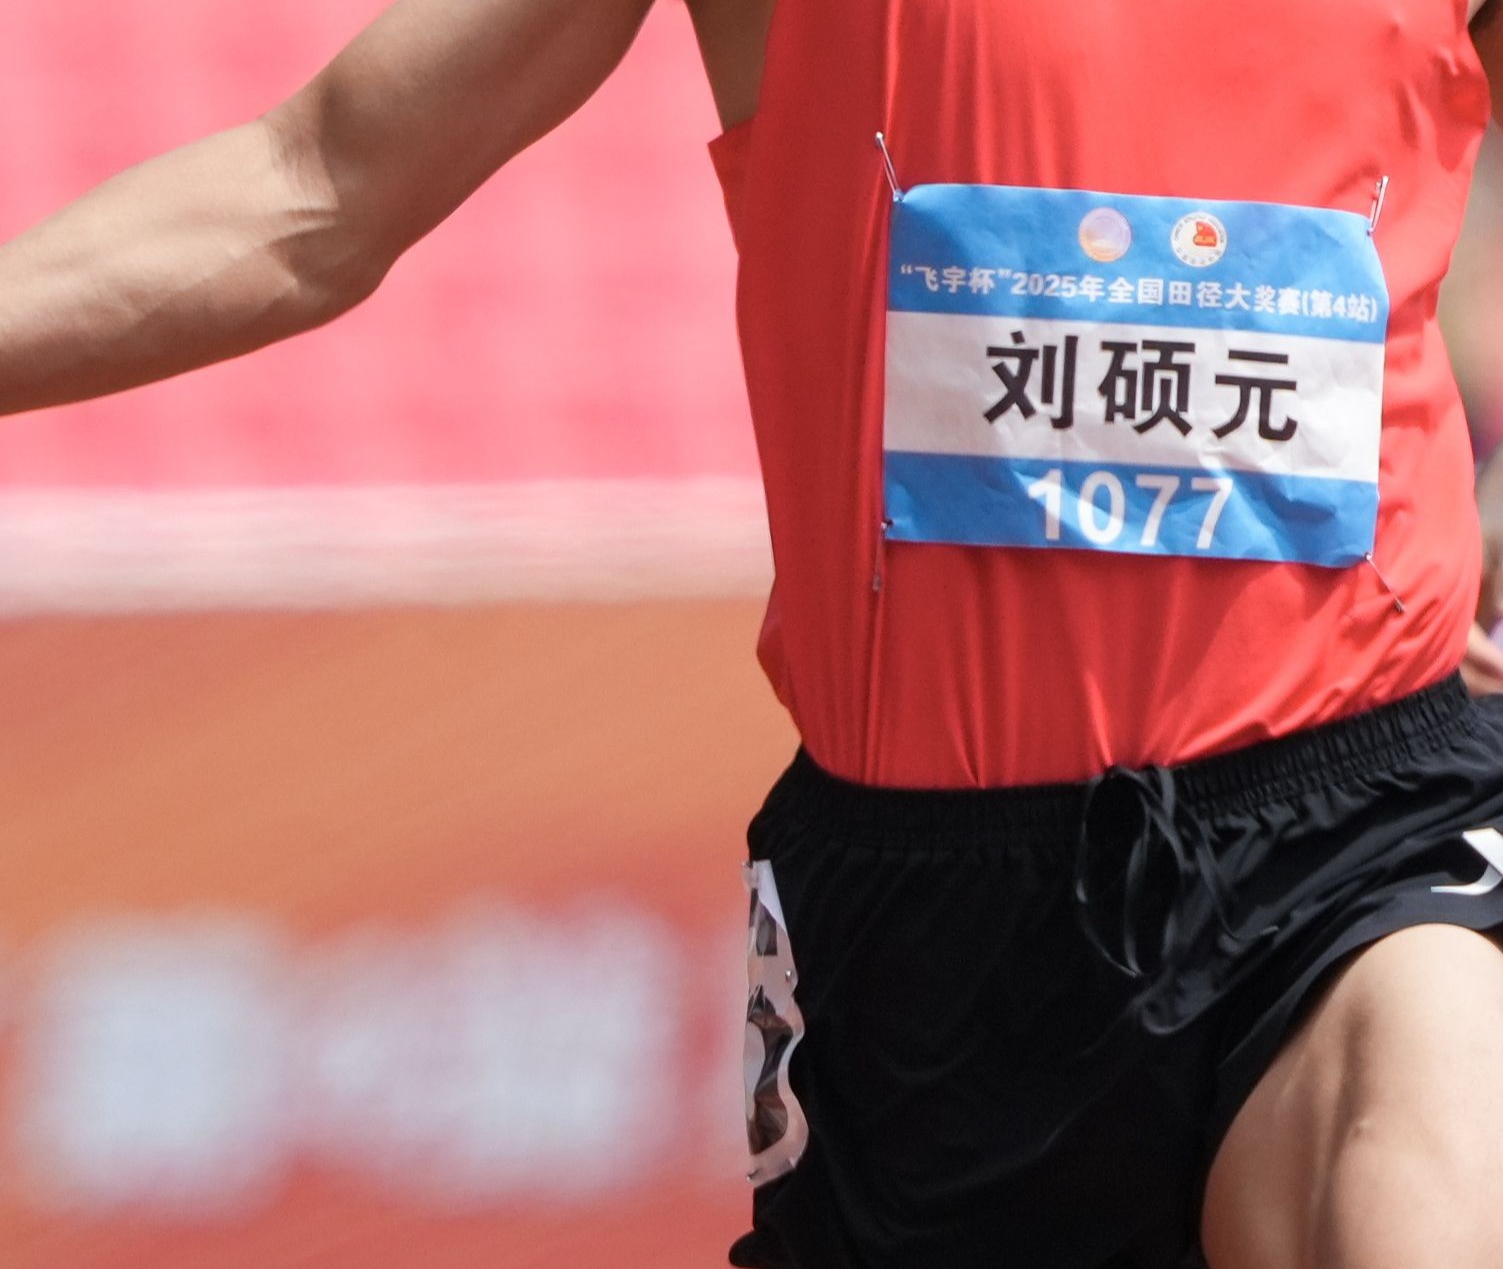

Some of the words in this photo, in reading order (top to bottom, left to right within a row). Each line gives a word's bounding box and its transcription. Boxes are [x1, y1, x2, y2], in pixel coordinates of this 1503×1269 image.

[983, 329, 1299, 443] 刘硕元
[1027, 467, 1234, 550] 1077
